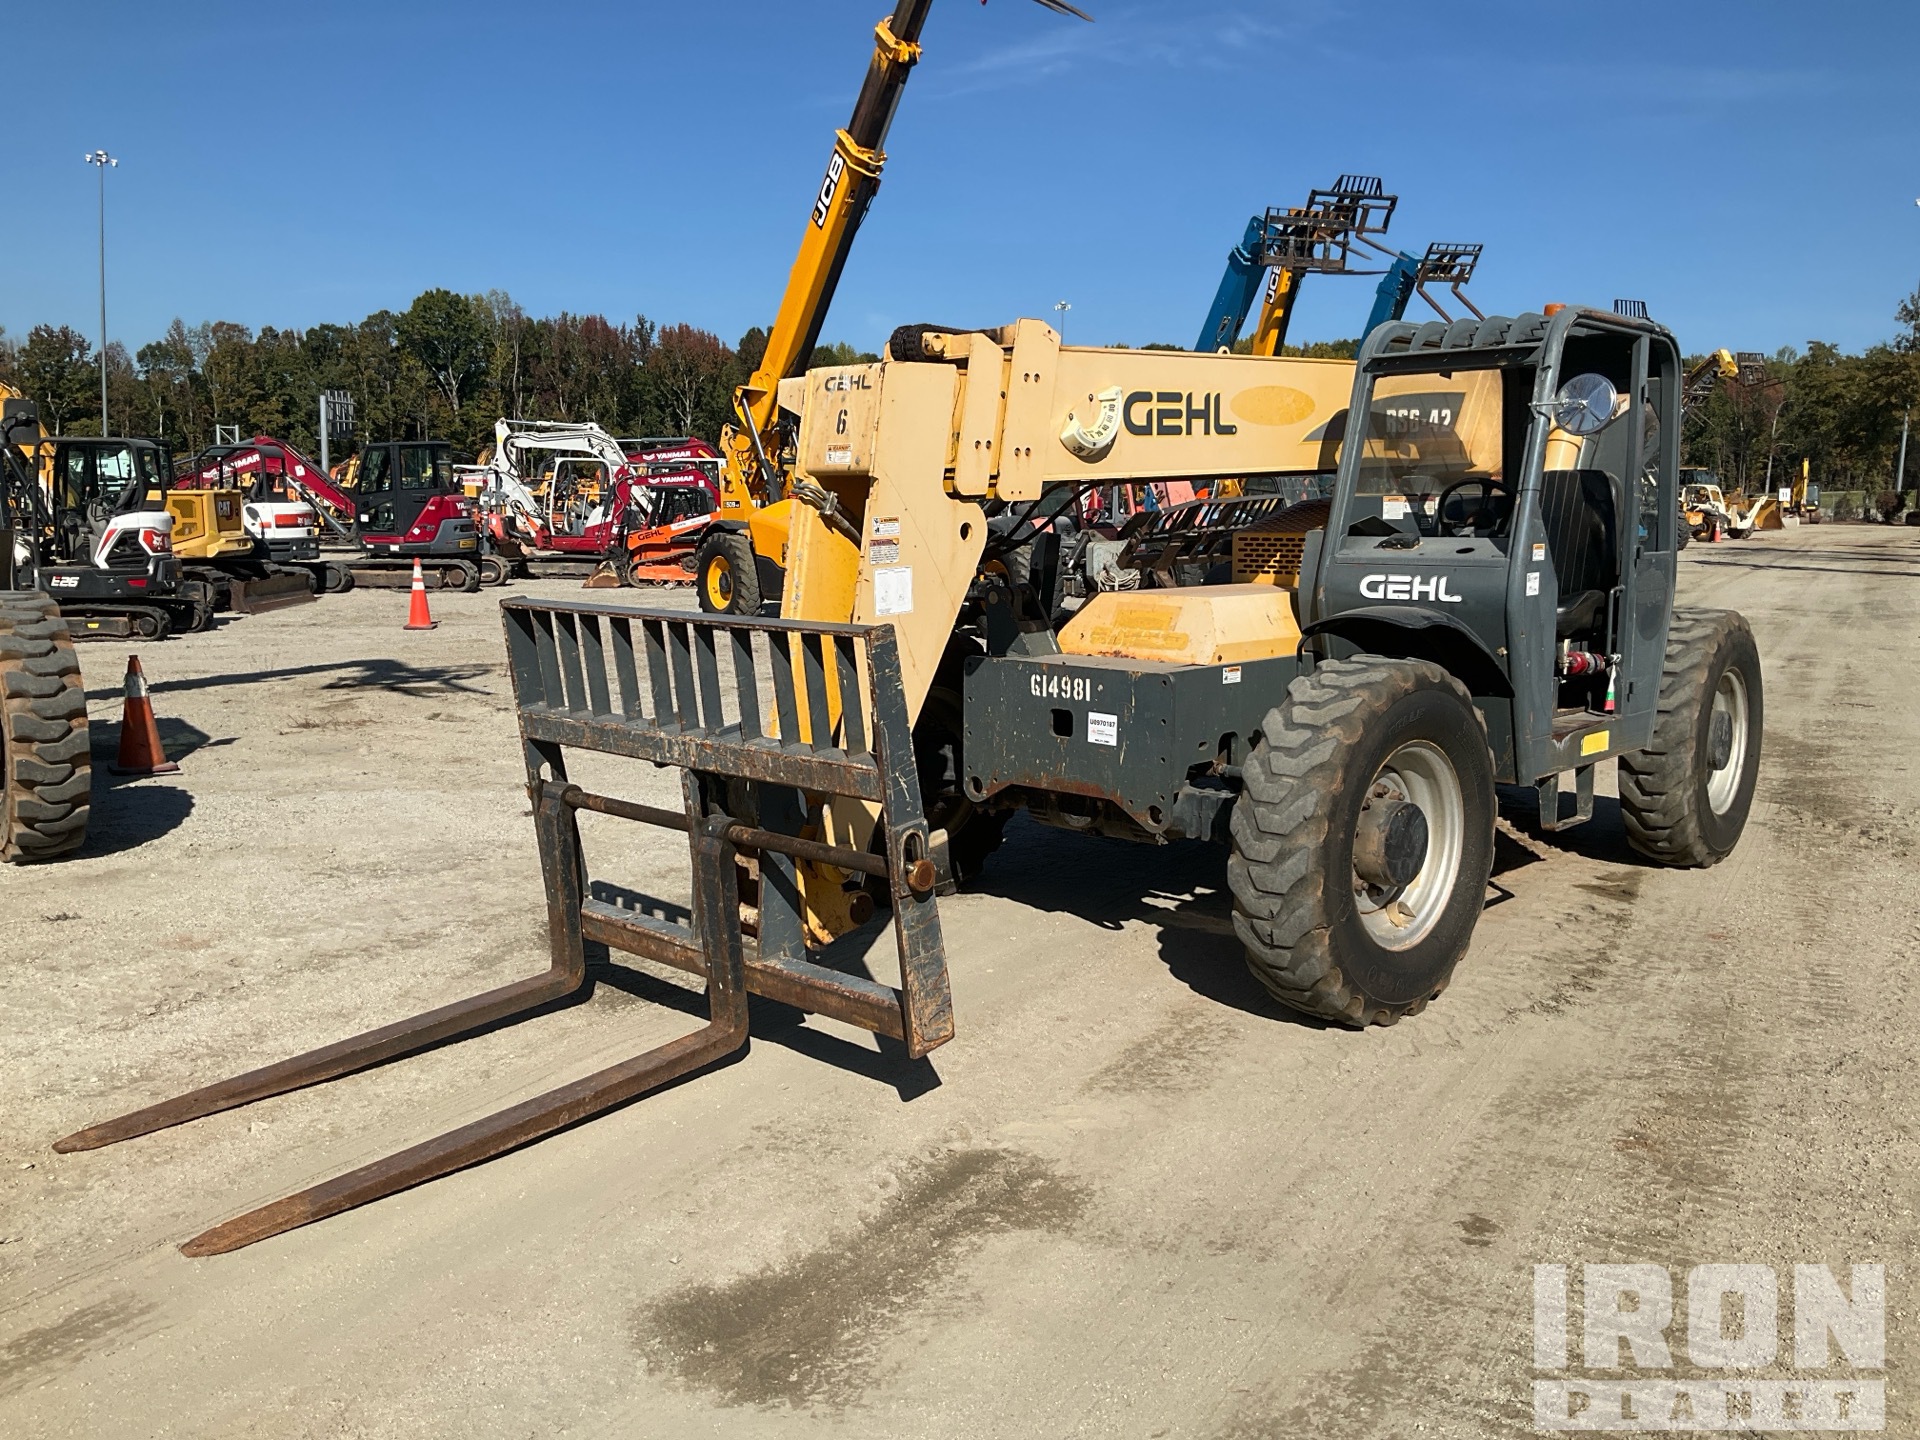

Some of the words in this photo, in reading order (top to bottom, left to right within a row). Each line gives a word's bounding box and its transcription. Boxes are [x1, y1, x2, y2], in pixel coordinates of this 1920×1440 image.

[816, 152, 844, 227] JCB
[825, 374, 872, 391] GEHL
[1123, 391, 1237, 436] GEHL
[836, 409, 848, 435] 6
[656, 451, 691, 459] YANMAR
[661, 475, 694, 483] YANMAR
[218, 501, 231, 516] CAT
[637, 530, 664, 540] GEHL
[51, 576, 80, 588] E26
[1360, 574, 1462, 602] GEHL
[1030, 673, 1091, 702] G14981
[1089, 719, 1116, 728] U0970187
